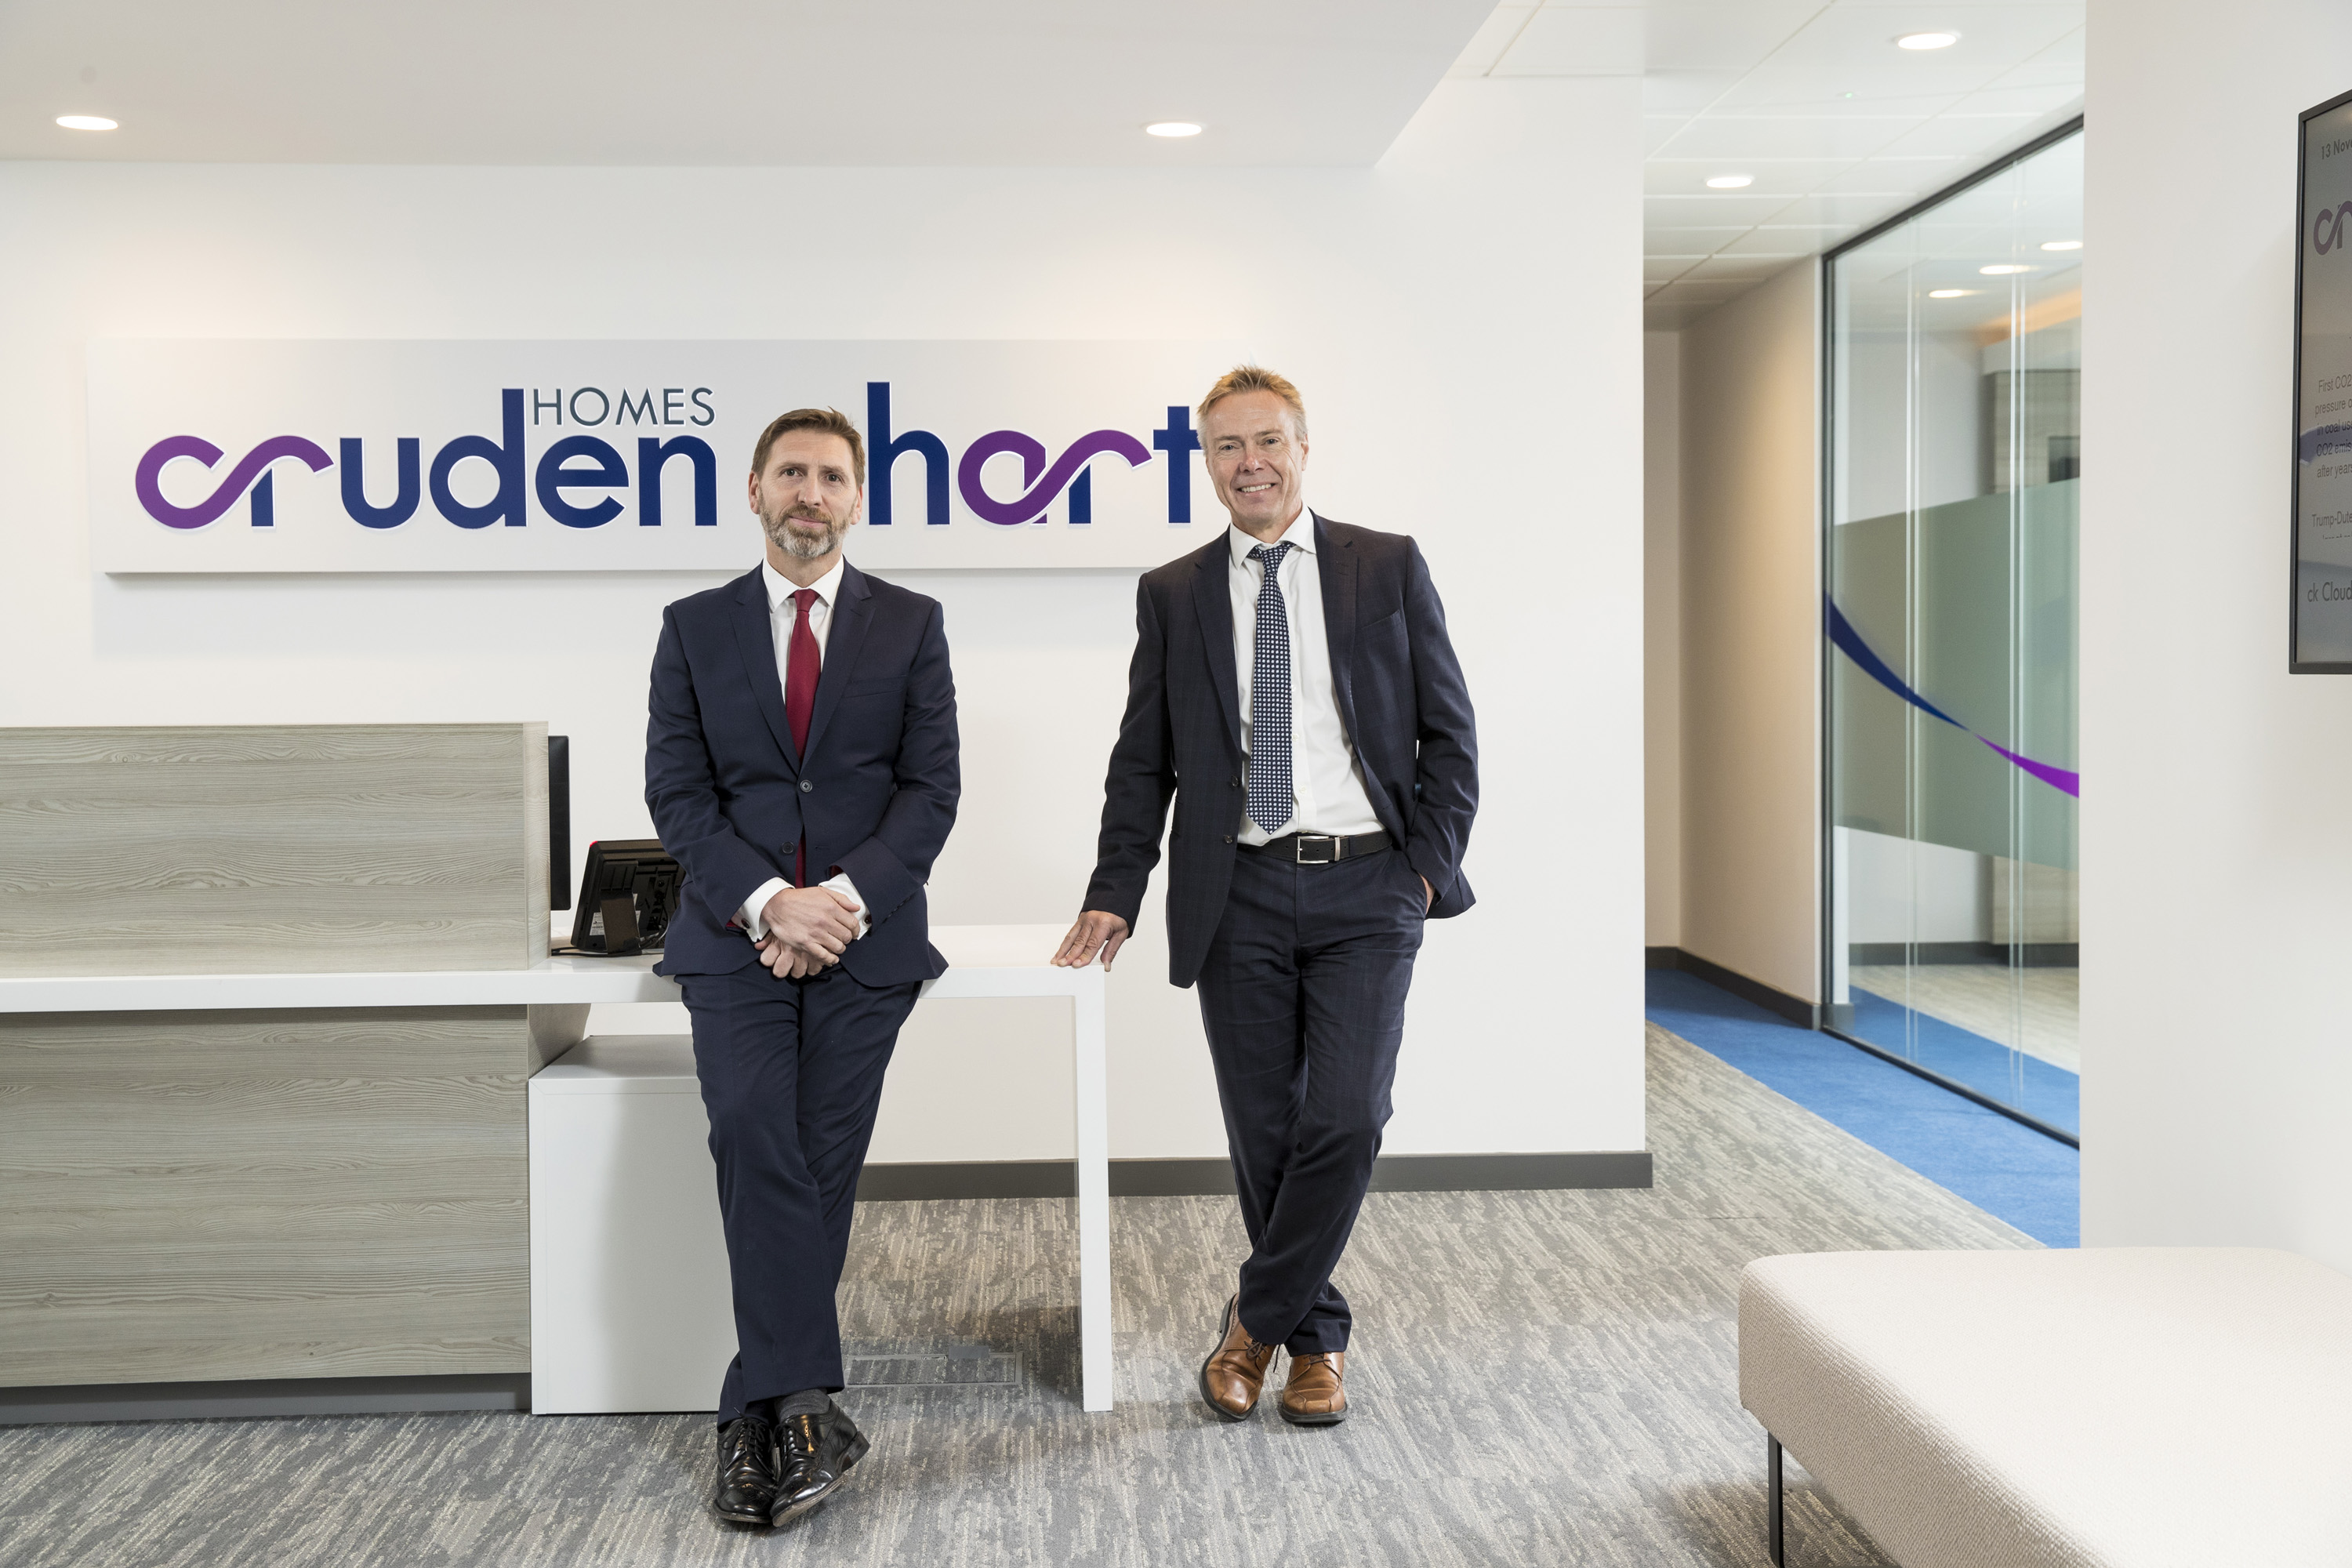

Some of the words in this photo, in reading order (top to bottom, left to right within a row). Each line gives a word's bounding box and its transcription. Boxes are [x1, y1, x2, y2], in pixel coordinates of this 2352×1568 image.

[2321, 143, 2331, 160] 13
[2318, 379, 2333, 393] First
[2335, 374, 2352, 390] CO2
[534, 387, 715, 426] HOMES
[2314, 400, 2346, 418] pressure
[2325, 419, 2340, 434] coal
[867, 382, 1201, 524] hart
[2316, 442, 2333, 457] CO2
[136, 389, 717, 529] cruden
[2317, 464, 2333, 478] after
